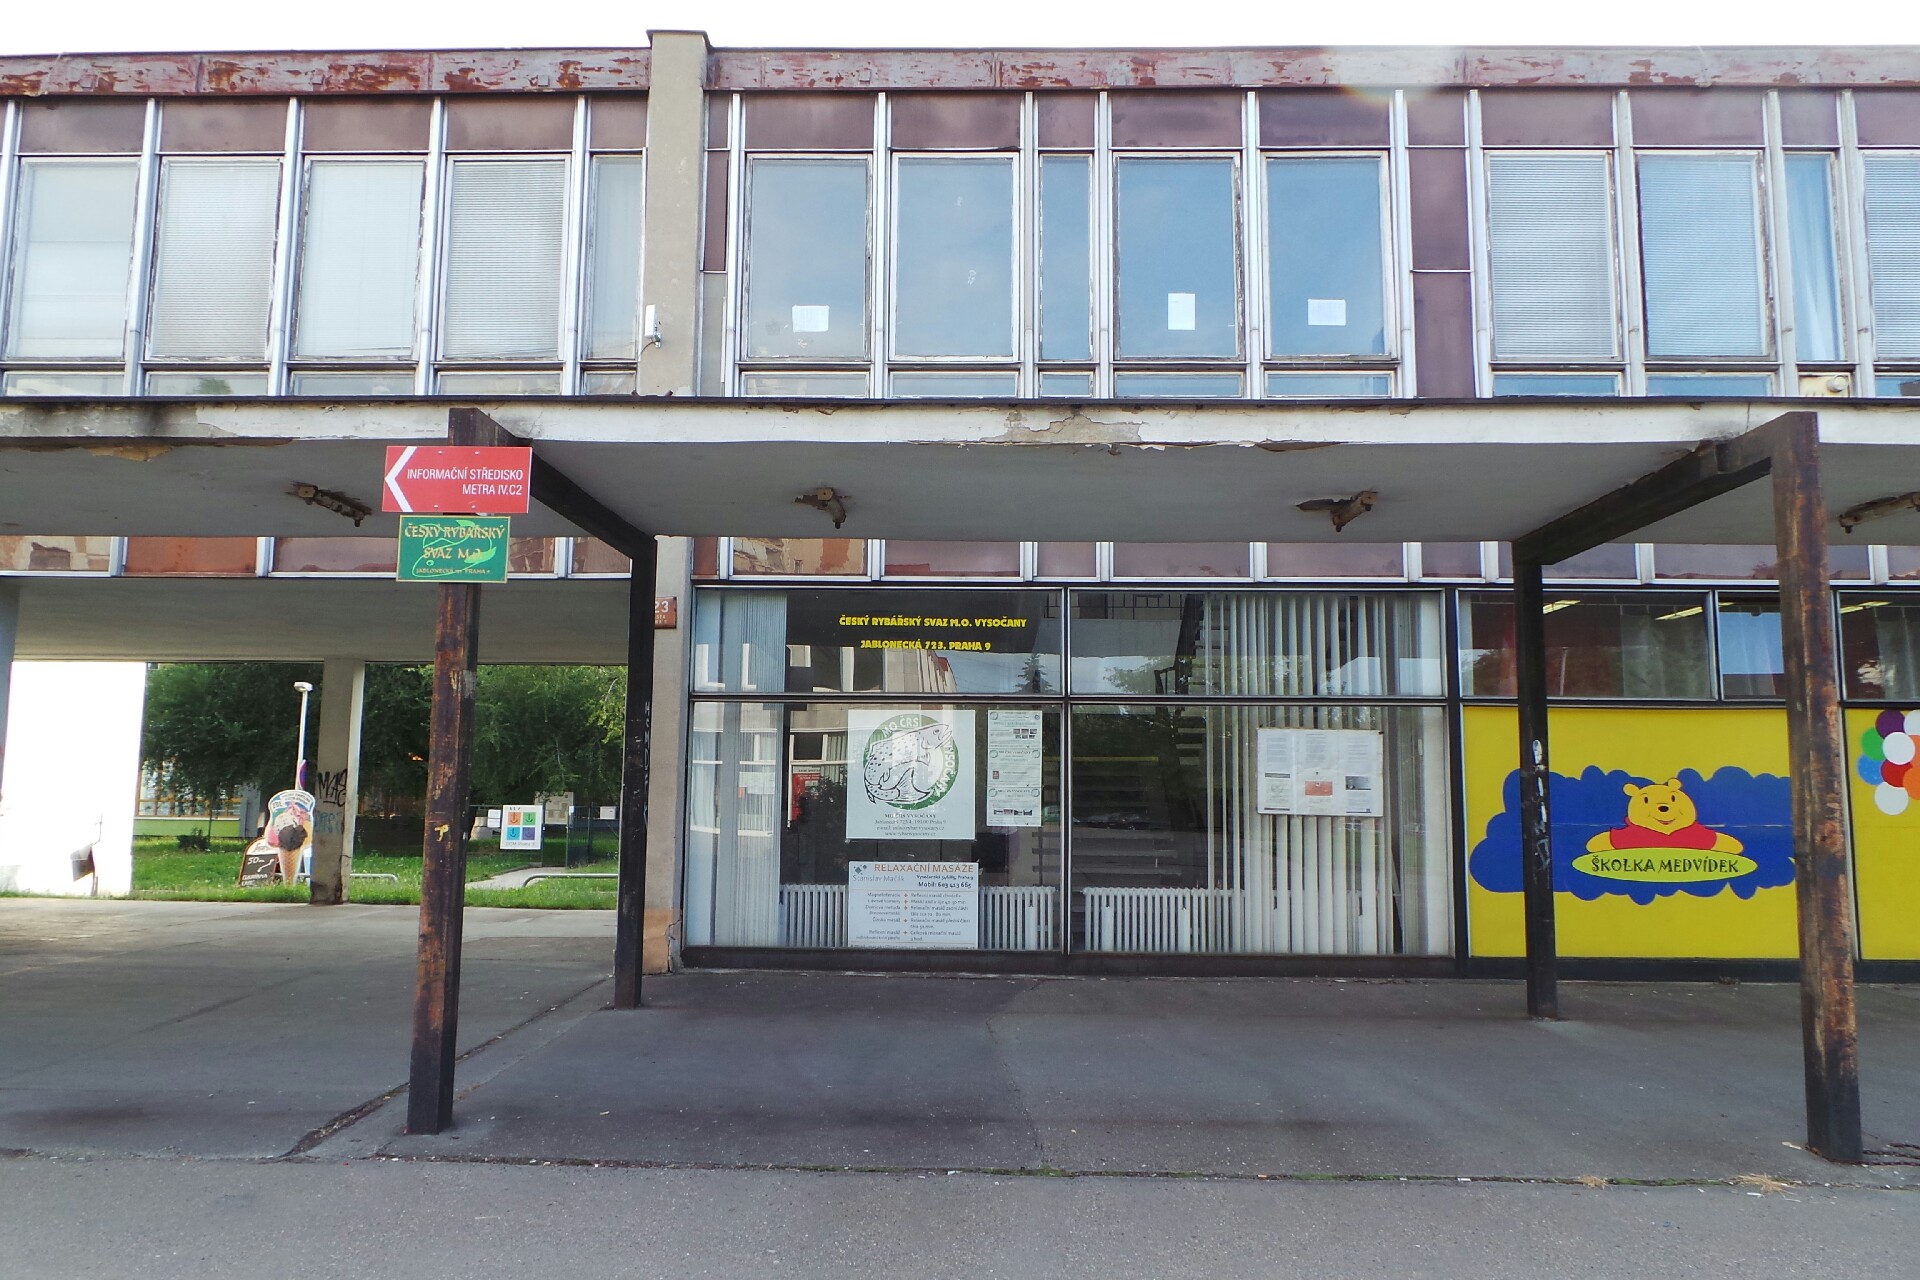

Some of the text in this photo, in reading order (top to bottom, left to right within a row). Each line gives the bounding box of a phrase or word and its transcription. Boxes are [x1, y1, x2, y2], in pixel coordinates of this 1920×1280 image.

[407, 466, 523, 481] INFORMAČNÍ STŘEDISKO
[462, 484, 523, 495] METRA IV.C2
[404, 522, 505, 539] ČESKÝ RYBÁŘSKÝ
[423, 547, 452, 559] SVAZ
[839, 614, 1027, 627] ČESKÝ RYBÁŘSKÝ SVAZ M.O. VYSOČANY
[860, 639, 921, 650] JABLONECKÁ
[949, 641, 982, 651] PRAHA
[984, 642, 991, 651] 9
[882, 721, 898, 737] MO
[900, 715, 919, 728] ČRS
[874, 863, 930, 873] RELAXAČNÍ
[1591, 854, 1739, 874] ŠKOLKA MEDVÍDEK
